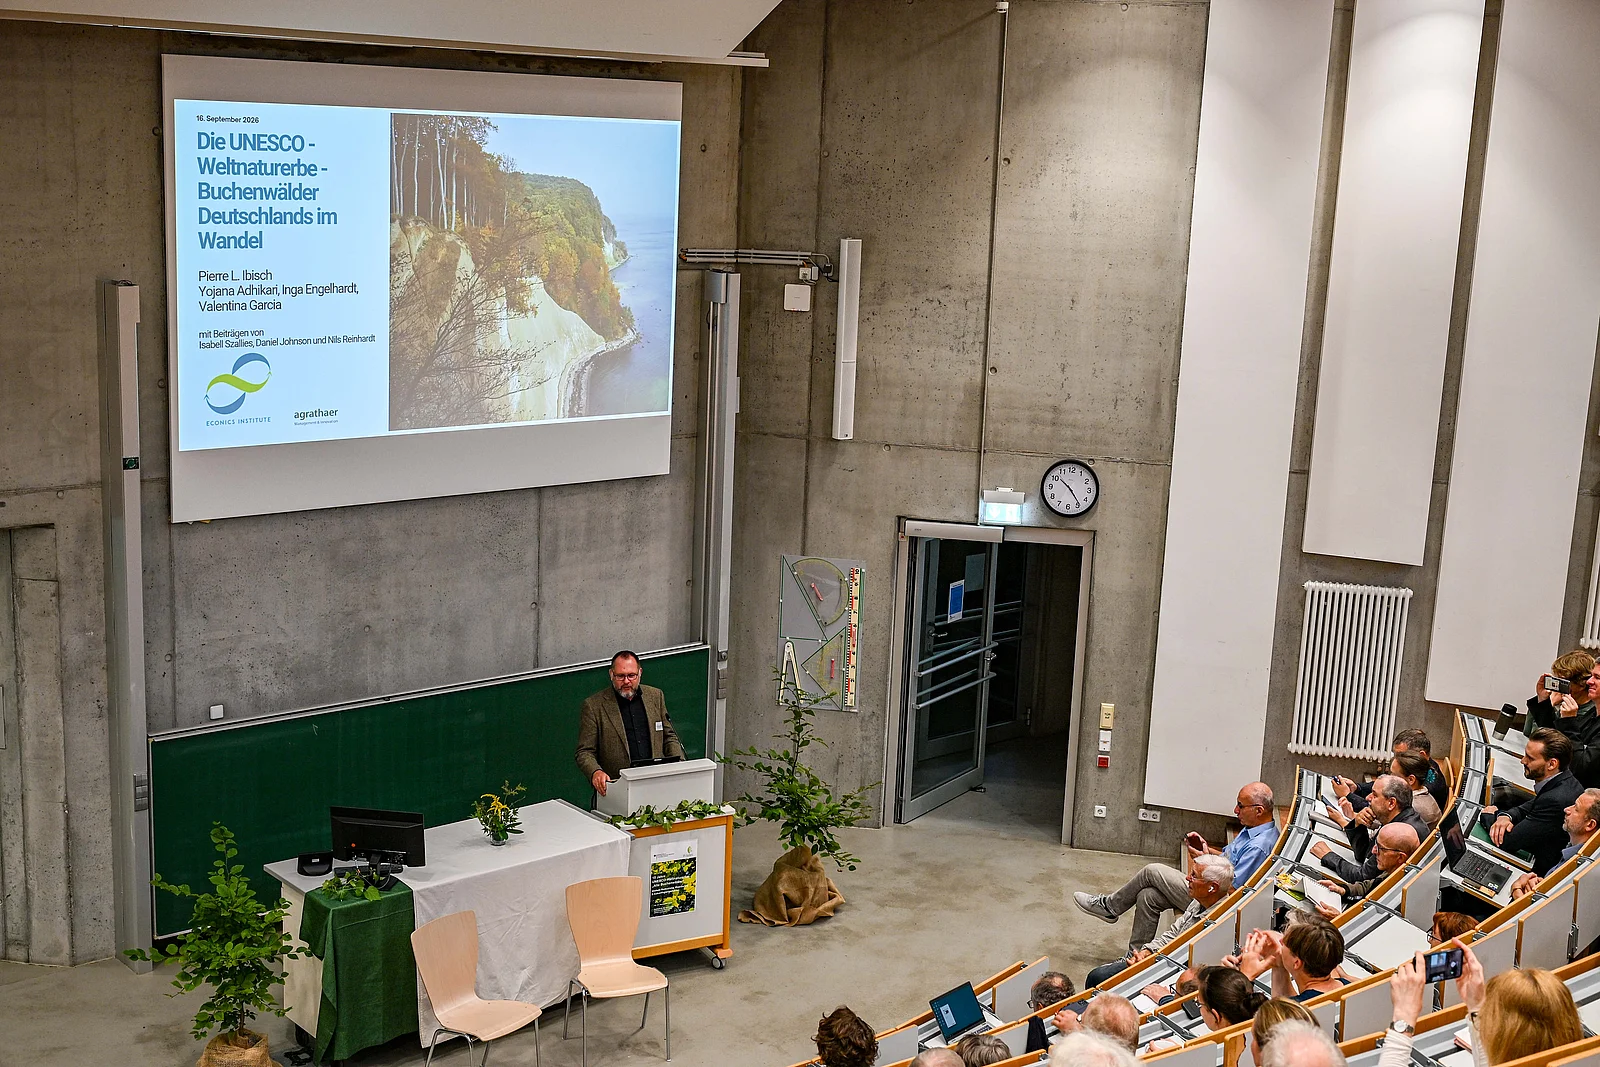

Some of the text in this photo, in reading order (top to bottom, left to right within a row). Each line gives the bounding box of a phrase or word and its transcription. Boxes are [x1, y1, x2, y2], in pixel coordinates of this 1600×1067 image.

[206, 115, 242, 124] September
[197, 131, 226, 150] Die
[229, 133, 305, 152] UNESCO
[197, 157, 318, 177] Weltnaturerbe
[198, 182, 320, 201] Buchenwälder
[198, 206, 338, 225] Deutschlands im
[198, 230, 263, 250] Wandel
[198, 269, 272, 282] Pierre L. Ibisch
[198, 282, 359, 300] Yojana Adhikari, Inga Engelhardt,
[198, 299, 282, 312] Valentina Garcia
[199, 330, 212, 339] mit
[213, 329, 249, 340] Beiträgen
[199, 334, 376, 349] Isabell Szallies, Daniel Johnson und Nils Reinhardt
[238, 416, 272, 425] INSTITUTE
[294, 408, 338, 420] agrathaer
